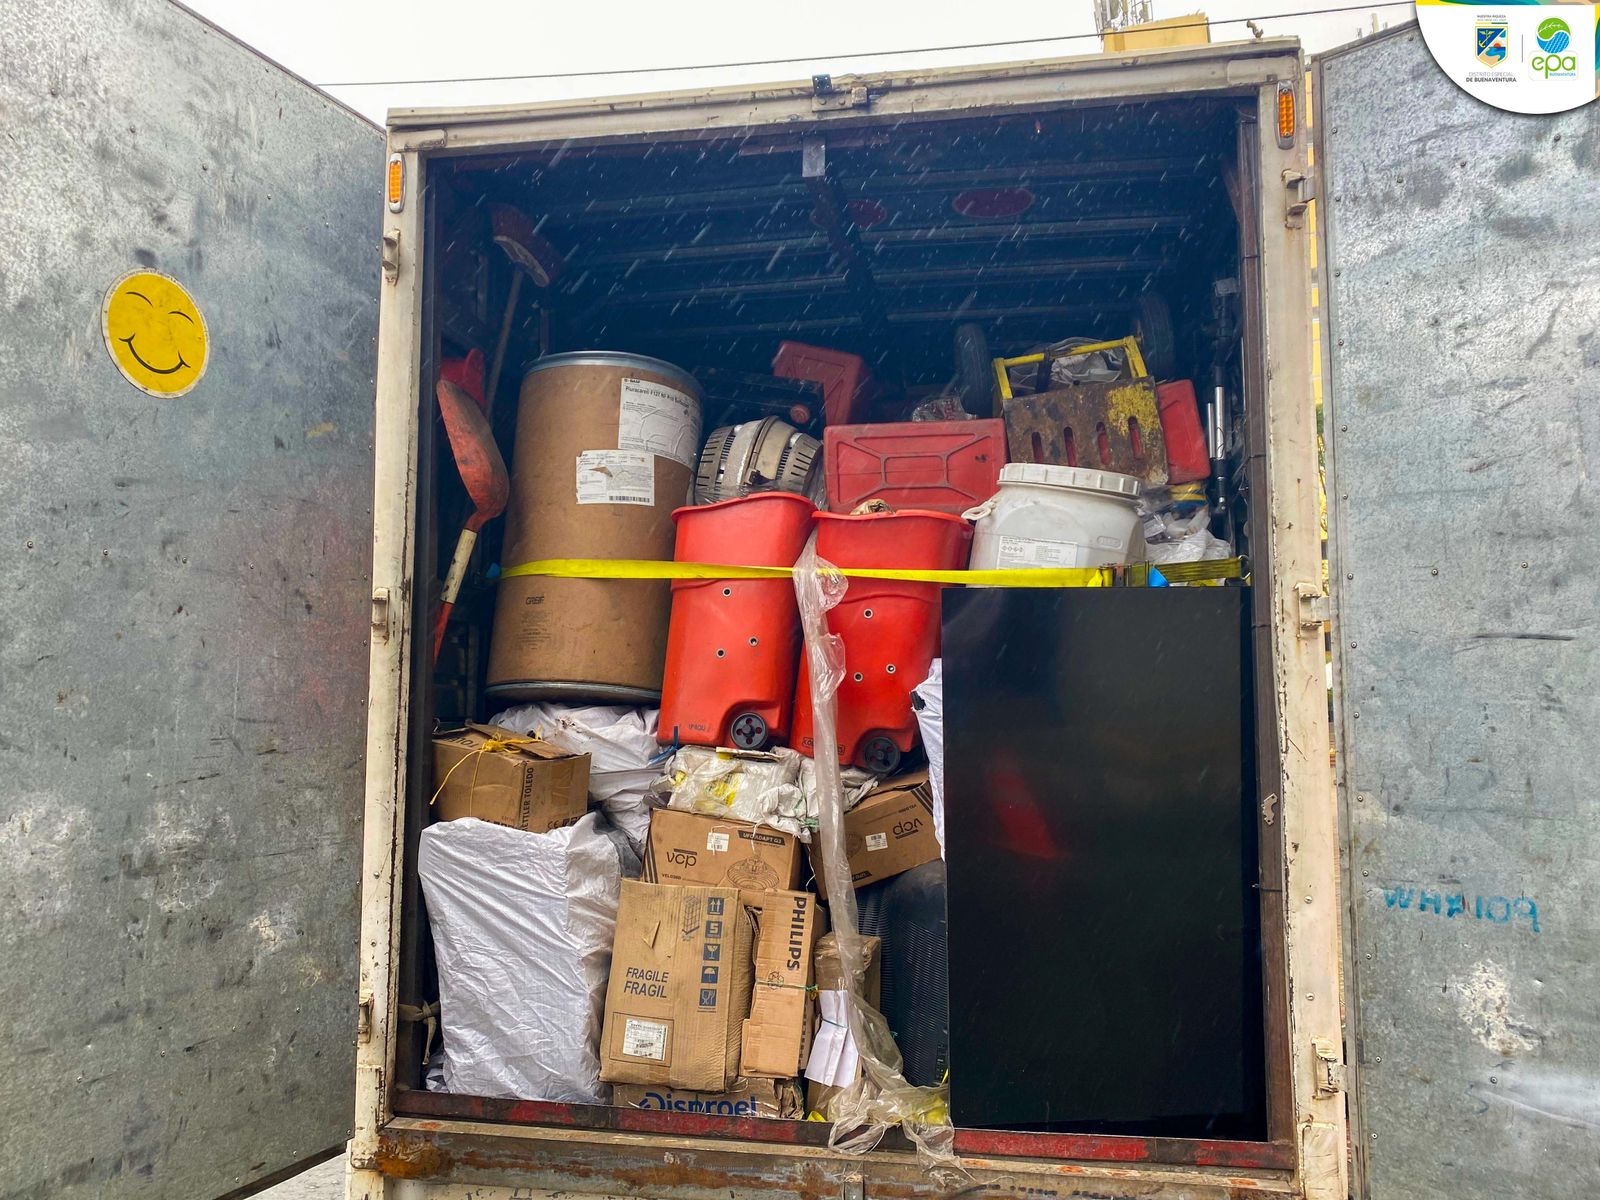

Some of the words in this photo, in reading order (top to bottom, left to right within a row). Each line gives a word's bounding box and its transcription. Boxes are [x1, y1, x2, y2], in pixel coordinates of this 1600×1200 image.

[524, 767, 534, 799] TOLEDO
[892, 817, 924, 836] vcp
[666, 851, 698, 869] vcp
[787, 896, 807, 971] PHILIPS
[625, 966, 670, 983] FRAGILE
[623, 980, 668, 999] FRAGIL
